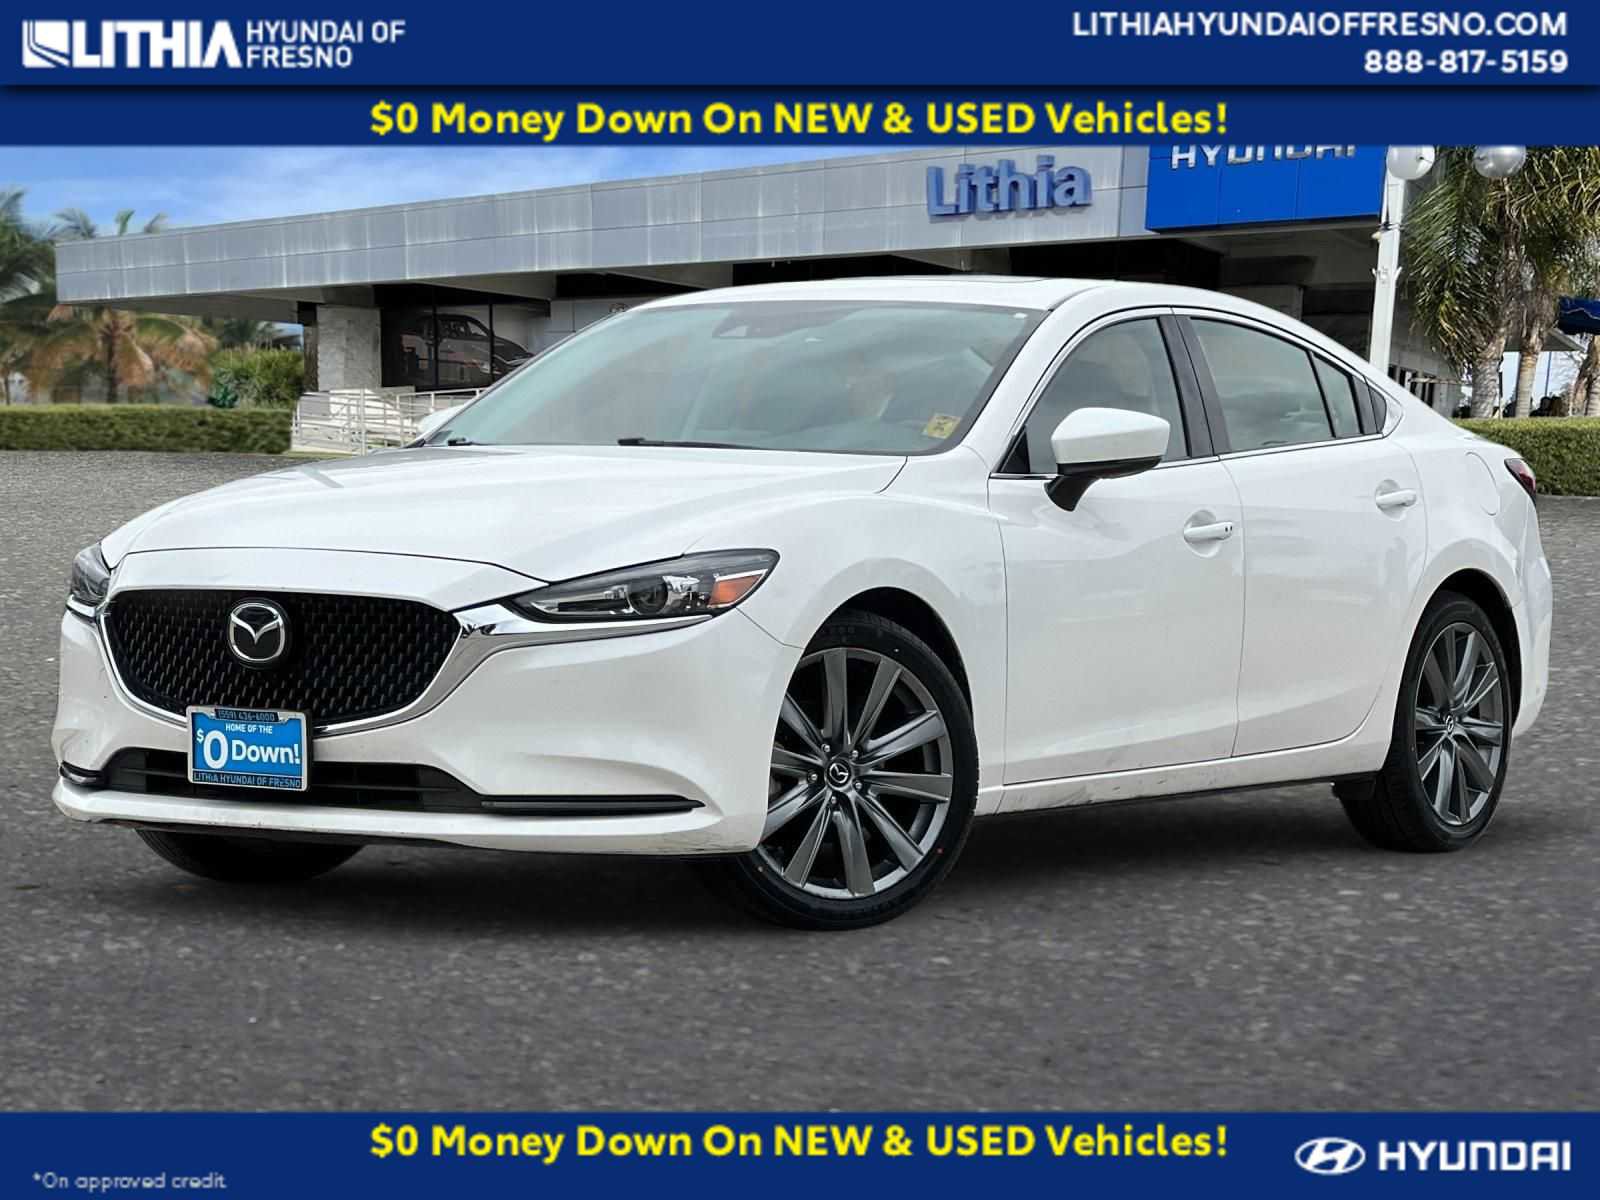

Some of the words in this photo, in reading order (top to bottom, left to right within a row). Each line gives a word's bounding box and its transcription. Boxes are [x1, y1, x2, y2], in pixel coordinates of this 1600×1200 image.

[927, 154, 1092, 216] Lithia
[225, 723, 246, 733] HOME
[247, 724, 257, 733] OF
[258, 725, 273, 735] THE
[196, 728, 228, 769] $0
[231, 739, 301, 764] Down!
[193, 772, 219, 783] LITHIA
[220, 774, 255, 785] HYUNDAI
[256, 777, 267, 786] OF
[268, 777, 301, 788] FRESNO
